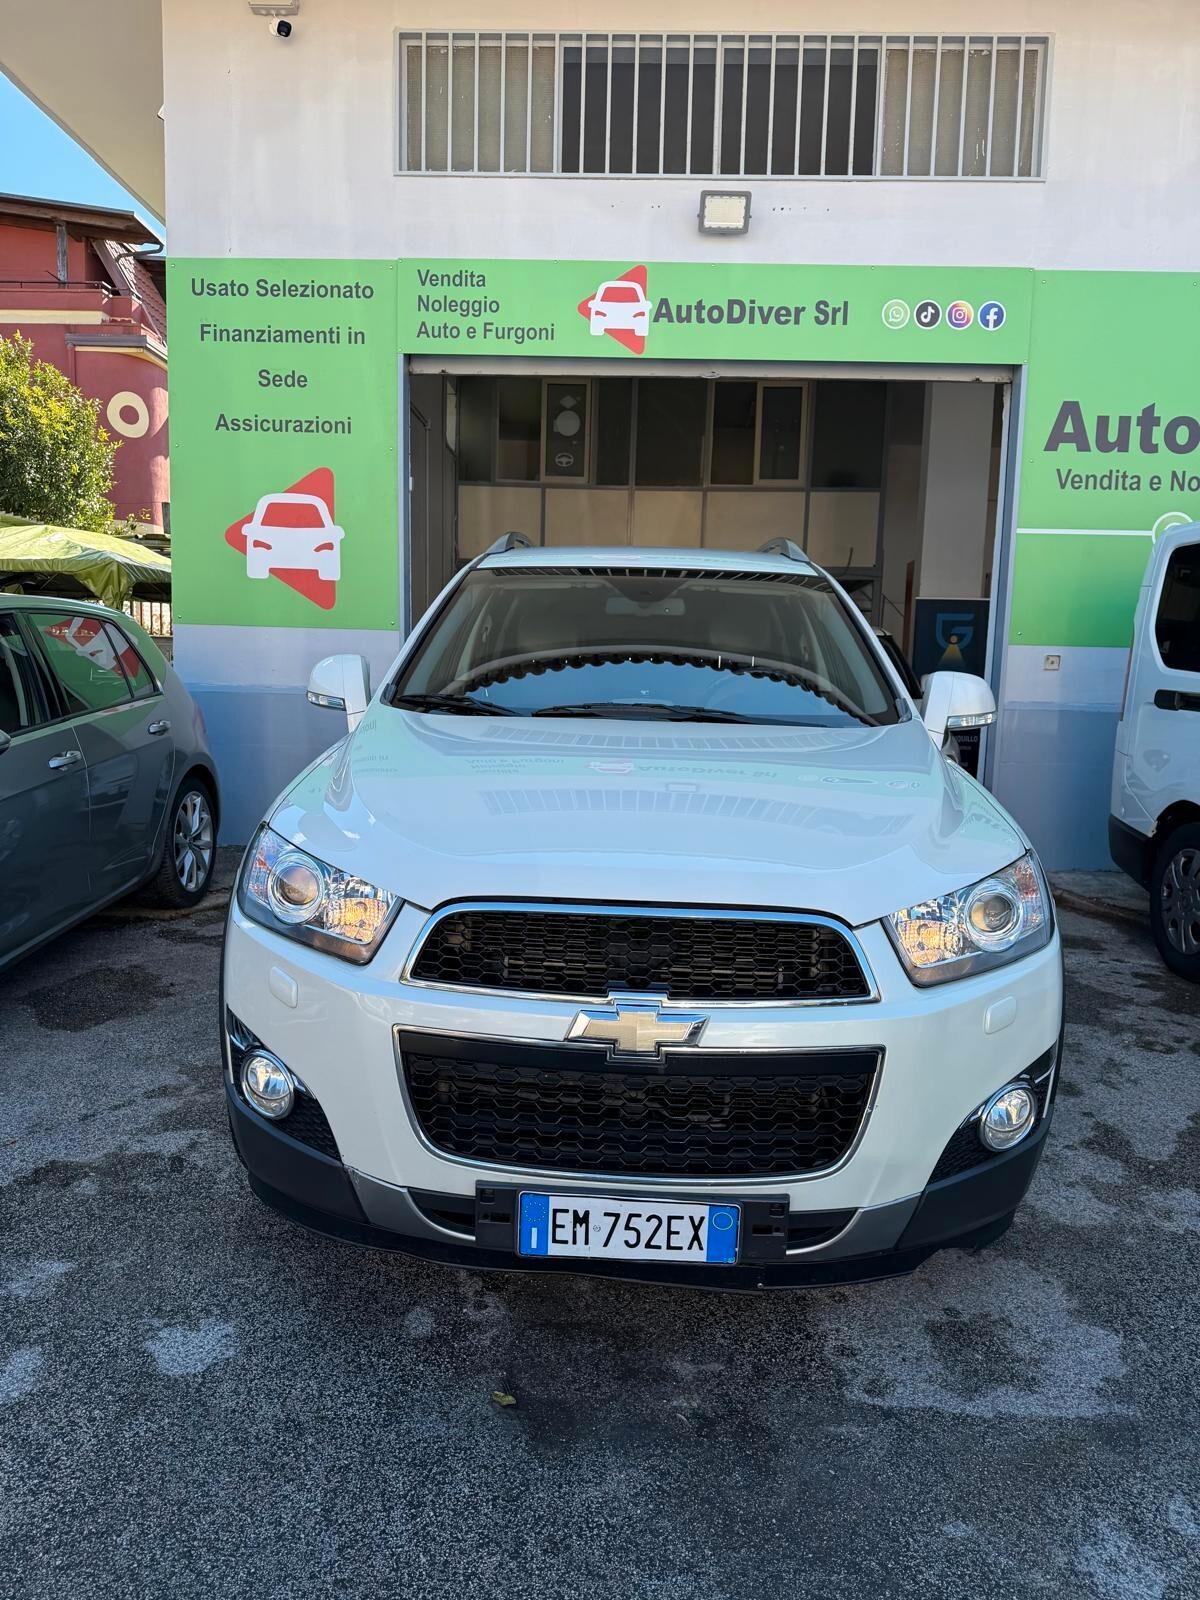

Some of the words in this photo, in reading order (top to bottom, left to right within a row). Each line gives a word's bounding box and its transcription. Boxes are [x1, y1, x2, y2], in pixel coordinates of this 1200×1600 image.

[191, 277, 249, 297] Usato
[255, 278, 375, 299] Selezionato
[417, 269, 486, 288] Vendita
[417, 294, 500, 318] Noleggio
[652, 297, 806, 325] AutoDiver
[814, 300, 849, 326] Srl
[200, 323, 340, 344] Finanziamenti
[348, 328, 365, 345] in
[416, 321, 461, 339] Auto
[466, 326, 477, 340] e
[483, 322, 555, 345] Furgoni
[257, 368, 308, 388] Sede
[214, 413, 352, 434] Assicurazioni
[1043, 400, 1200, 455] Auto
[1056, 468, 1141, 491] Vendita
[1149, 475, 1162, 492] e
[1170, 470, 1200, 492] No
[551, 1208, 591, 1246] EM
[602, 1211, 706, 1251] 752EX
